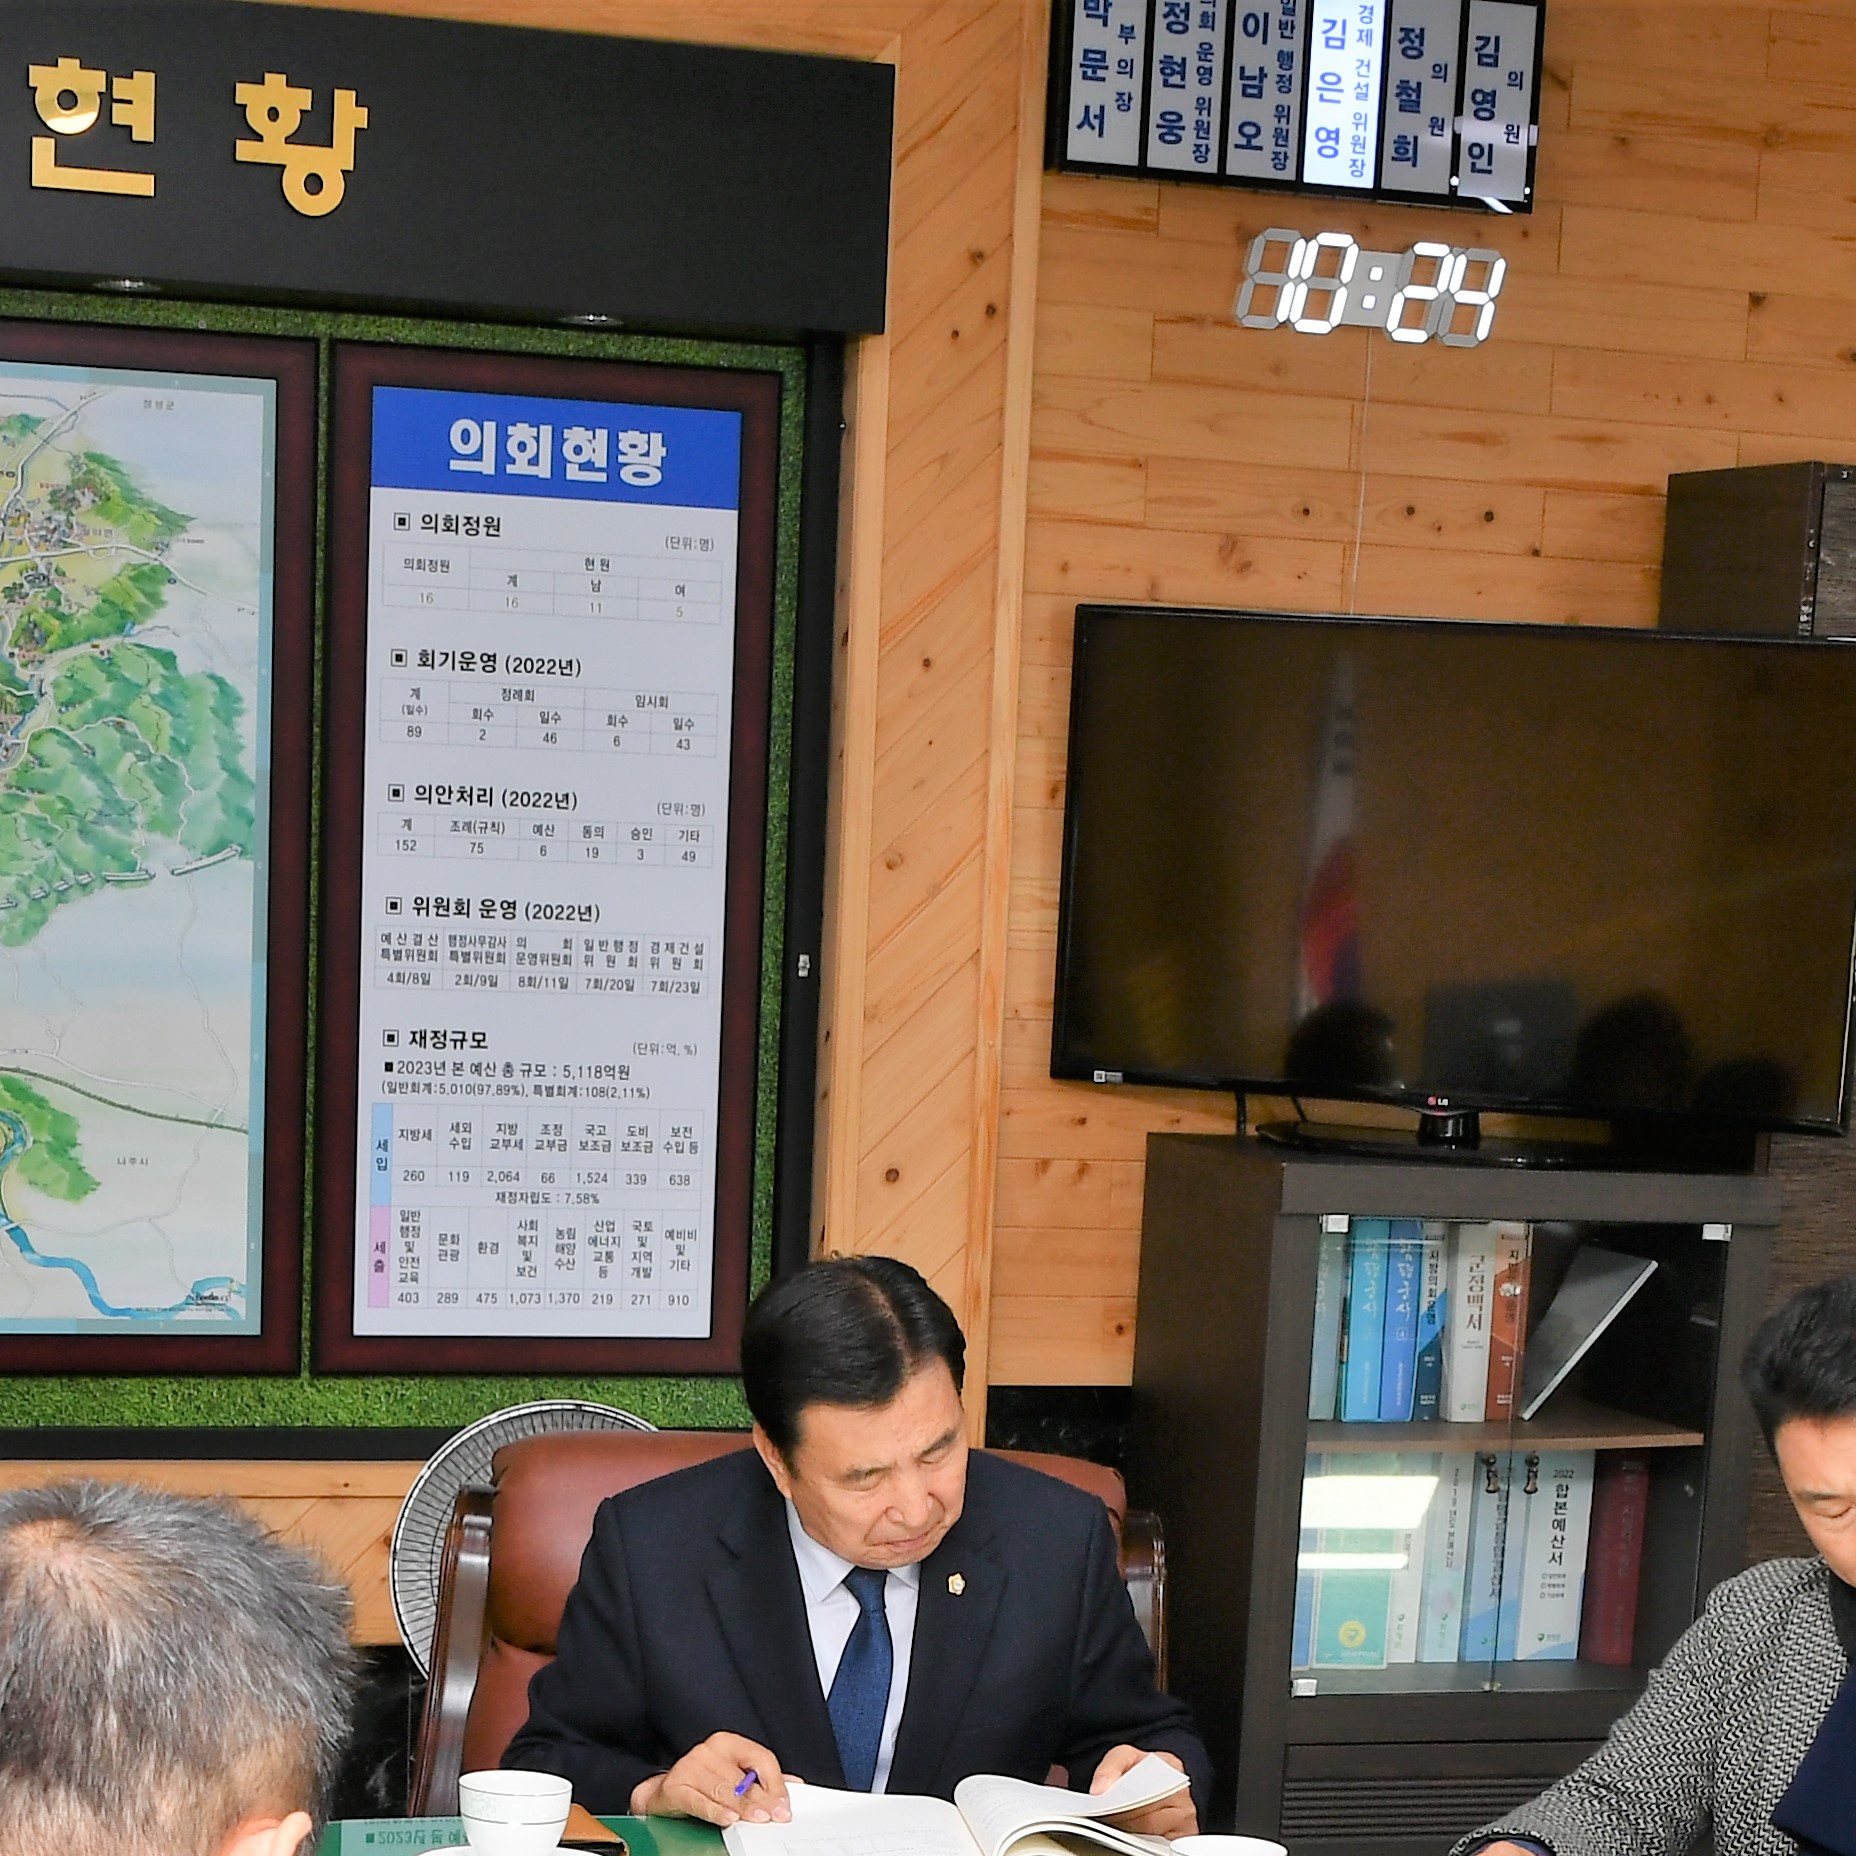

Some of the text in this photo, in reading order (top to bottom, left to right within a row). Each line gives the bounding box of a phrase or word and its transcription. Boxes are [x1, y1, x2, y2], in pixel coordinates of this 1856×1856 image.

[1073, 0, 1113, 139] 박문서
[1114, 23, 1137, 113] 부의장
[1152, 0, 1191, 145] 정현웅
[1196, 41, 1215, 87] 운영
[1231, 8, 1270, 152] 이남오
[1275, 49, 1295, 95] 행정
[1311, 15, 1347, 159] 김은영
[1348, 4, 1375, 178] 경제 건설 위원장
[1388, 24, 1426, 168] 정철희
[1192, 96, 1212, 164] 위원장
[1428, 63, 1449, 137] 의원
[1464, 32, 1501, 175] 김영인
[1503, 70, 1524, 145] 의원
[29, 57, 369, 216] 현황
[1270, 104, 1291, 172] 위원장
[1276, 232, 1507, 343] 10:24
[449, 418, 668, 486] 의회현황
[420, 513, 501, 538] 의회정원
[665, 535, 714, 552] (단위:명)
[417, 649, 581, 678] 회기운영 (2022년)
[471, 707, 695, 732] 회수 일수 회수 일수
[635, 694, 669, 709] 임시회
[414, 784, 578, 812] 의안처리 (2022년)
[532, 823, 555, 838] 예산
[412, 896, 600, 924] 위원회 운영 (2022년)
[380, 947, 438, 963] 특별위원회
[449, 949, 506, 965] 특별위원회
[386, 971, 701, 995] 4회/8일 2회/9일 8회/11일 7회/20일 7회/23일
[396, 1060, 446, 1077] 2023년
[451, 1061, 465, 1077] 본
[469, 1061, 497, 1078] 예산
[519, 1062, 547, 1079] 규모
[562, 1064, 630, 1081] 5,118억원
[408, 1028, 488, 1051] 재정규모
[495, 1191, 552, 1205] 재정자립도
[1467, 1255, 1484, 1331] 군정백서
[1548, 1484, 1569, 1566] 합본예산서
